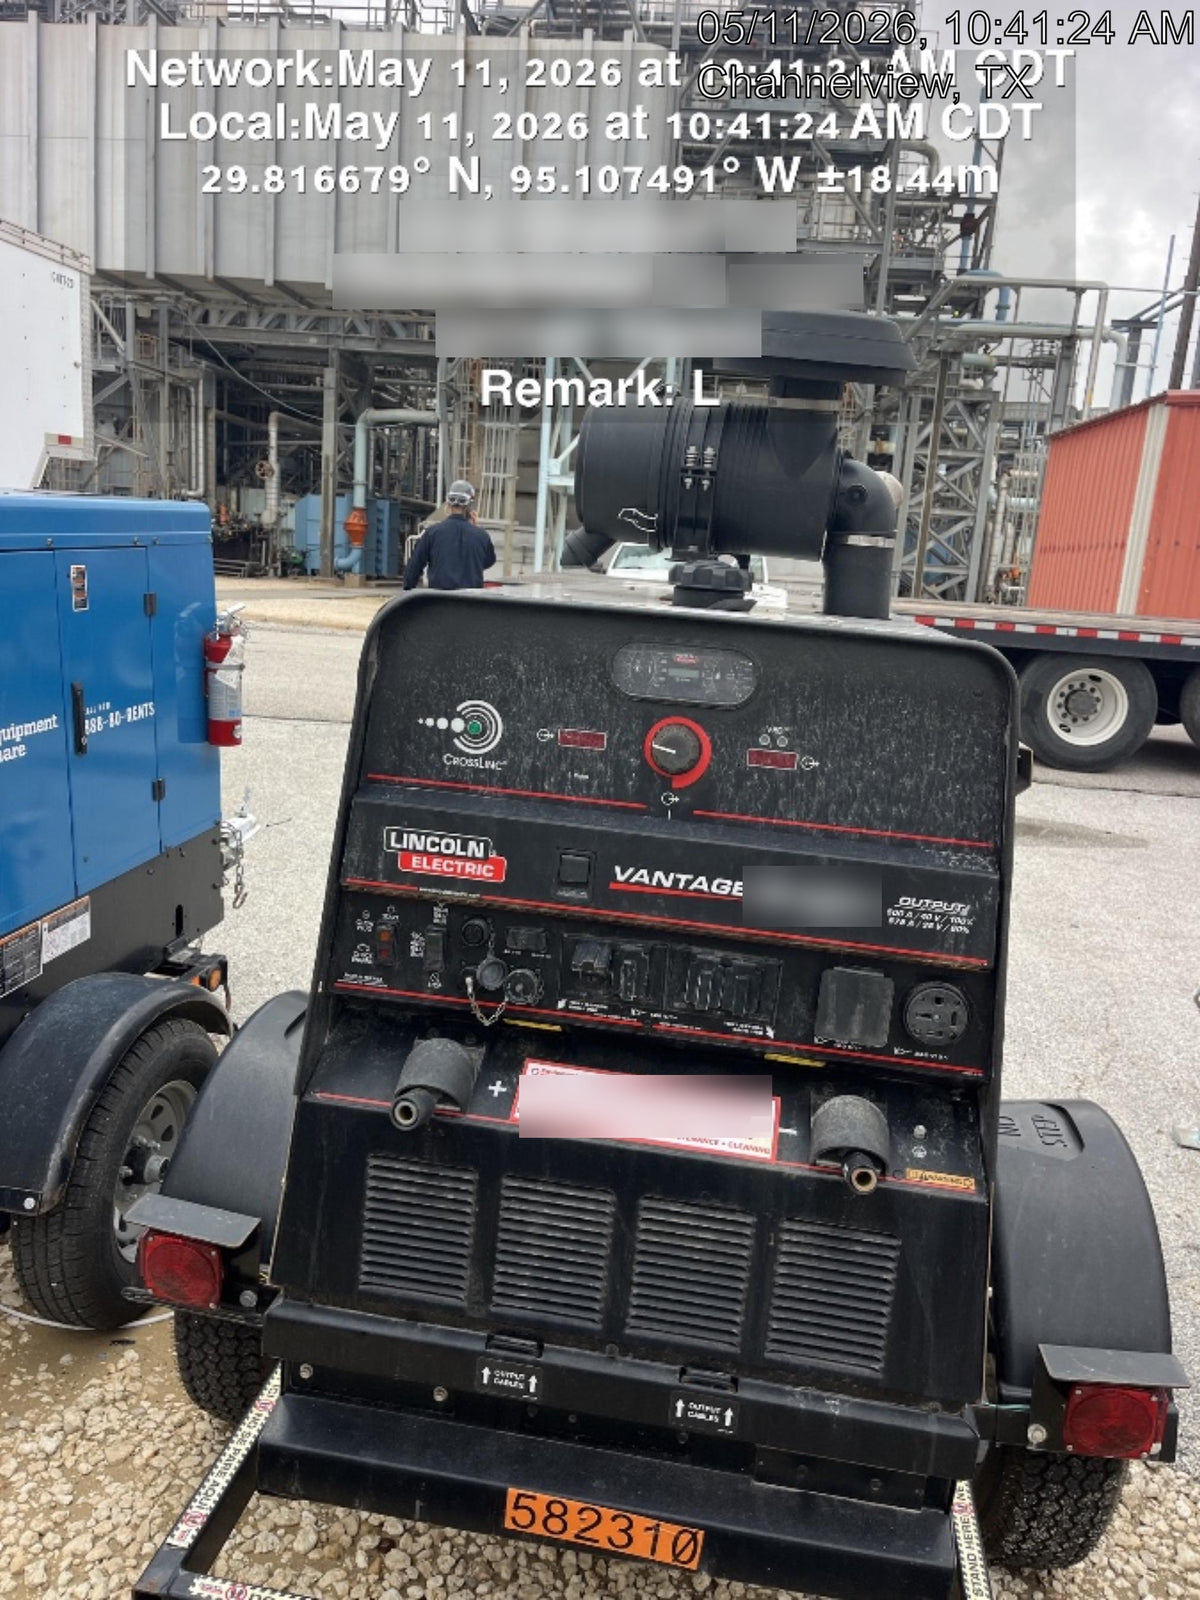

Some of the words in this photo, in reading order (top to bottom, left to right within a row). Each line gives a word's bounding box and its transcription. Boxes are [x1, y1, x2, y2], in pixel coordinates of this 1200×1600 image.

[390, 830, 485, 859] LINCOLN
[411, 856, 495, 878] ELECTRIC
[614, 864, 743, 897] VANTAGE
[510, 1492, 700, 1566] 582310
[960, 1516, 975, 1550] HERE
[966, 1552, 985, 1598] STAND
